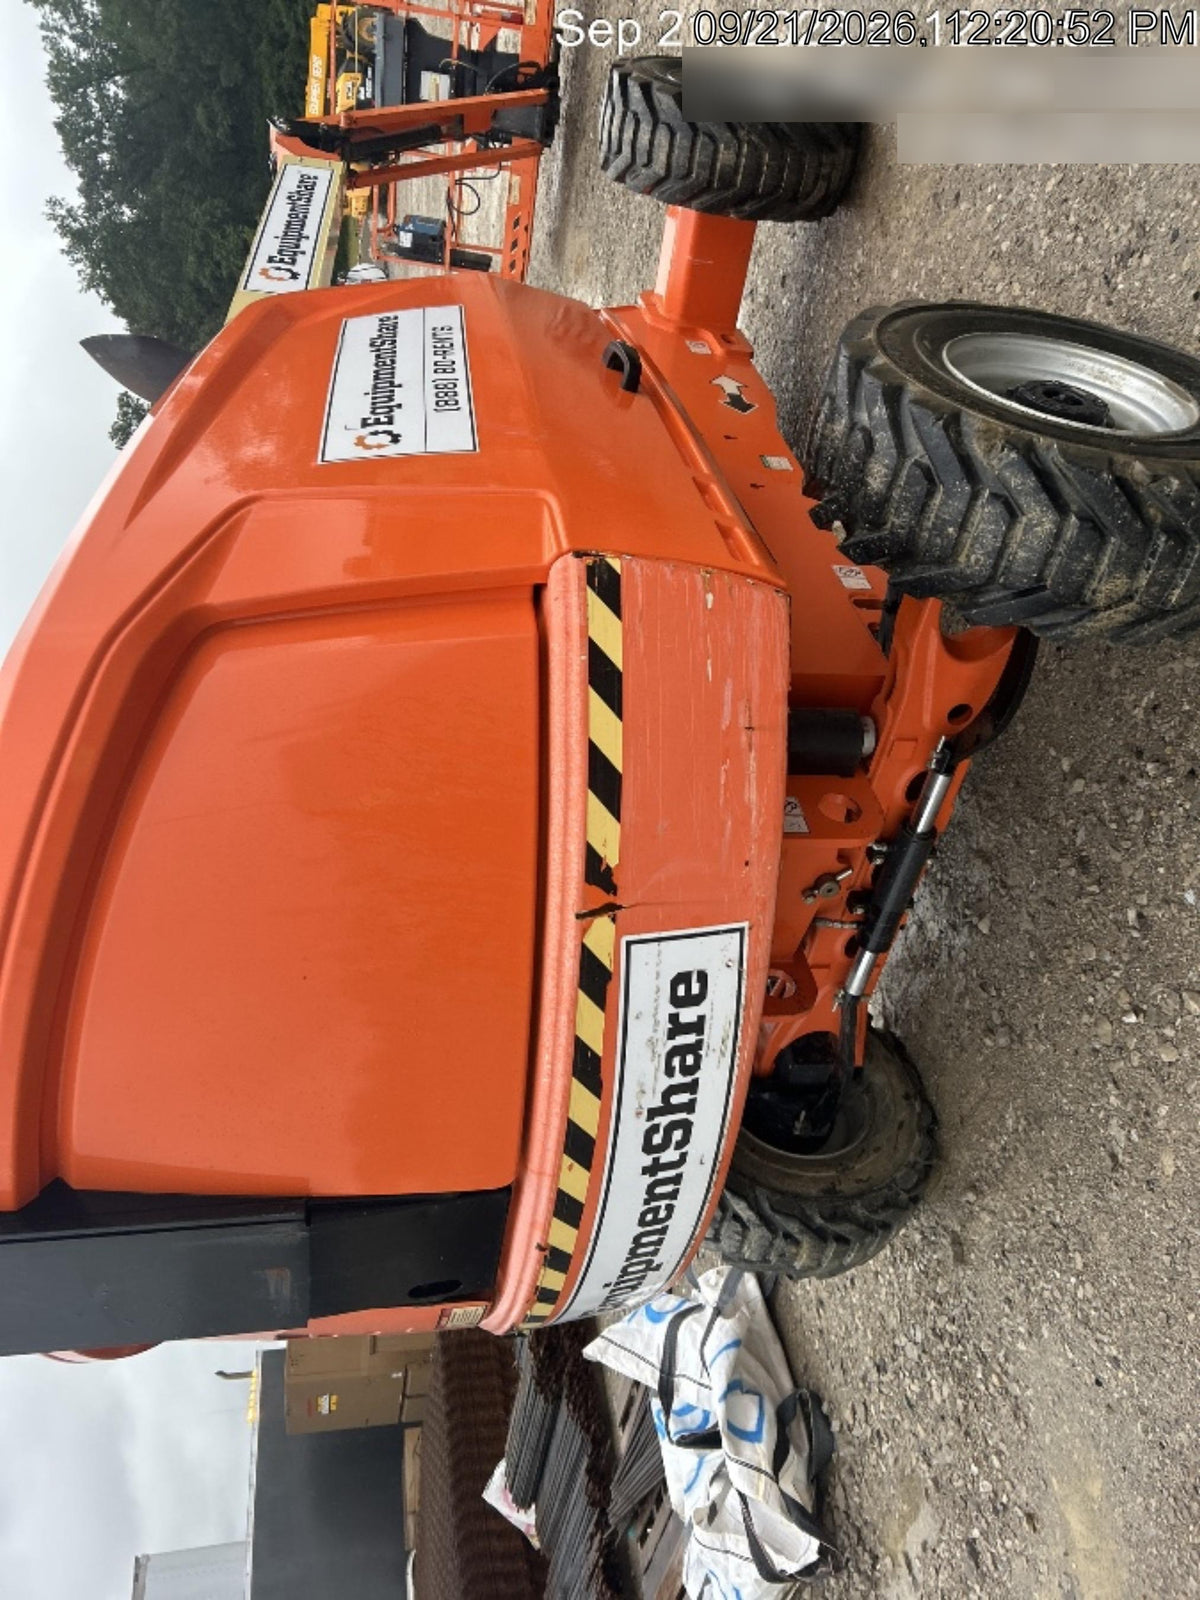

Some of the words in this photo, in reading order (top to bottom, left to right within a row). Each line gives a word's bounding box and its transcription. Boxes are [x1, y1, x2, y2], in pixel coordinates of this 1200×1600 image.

[266, 173, 319, 266] EquipmentShare
[360, 314, 403, 429] EquipmentShare
[431, 378, 462, 413] (888)
